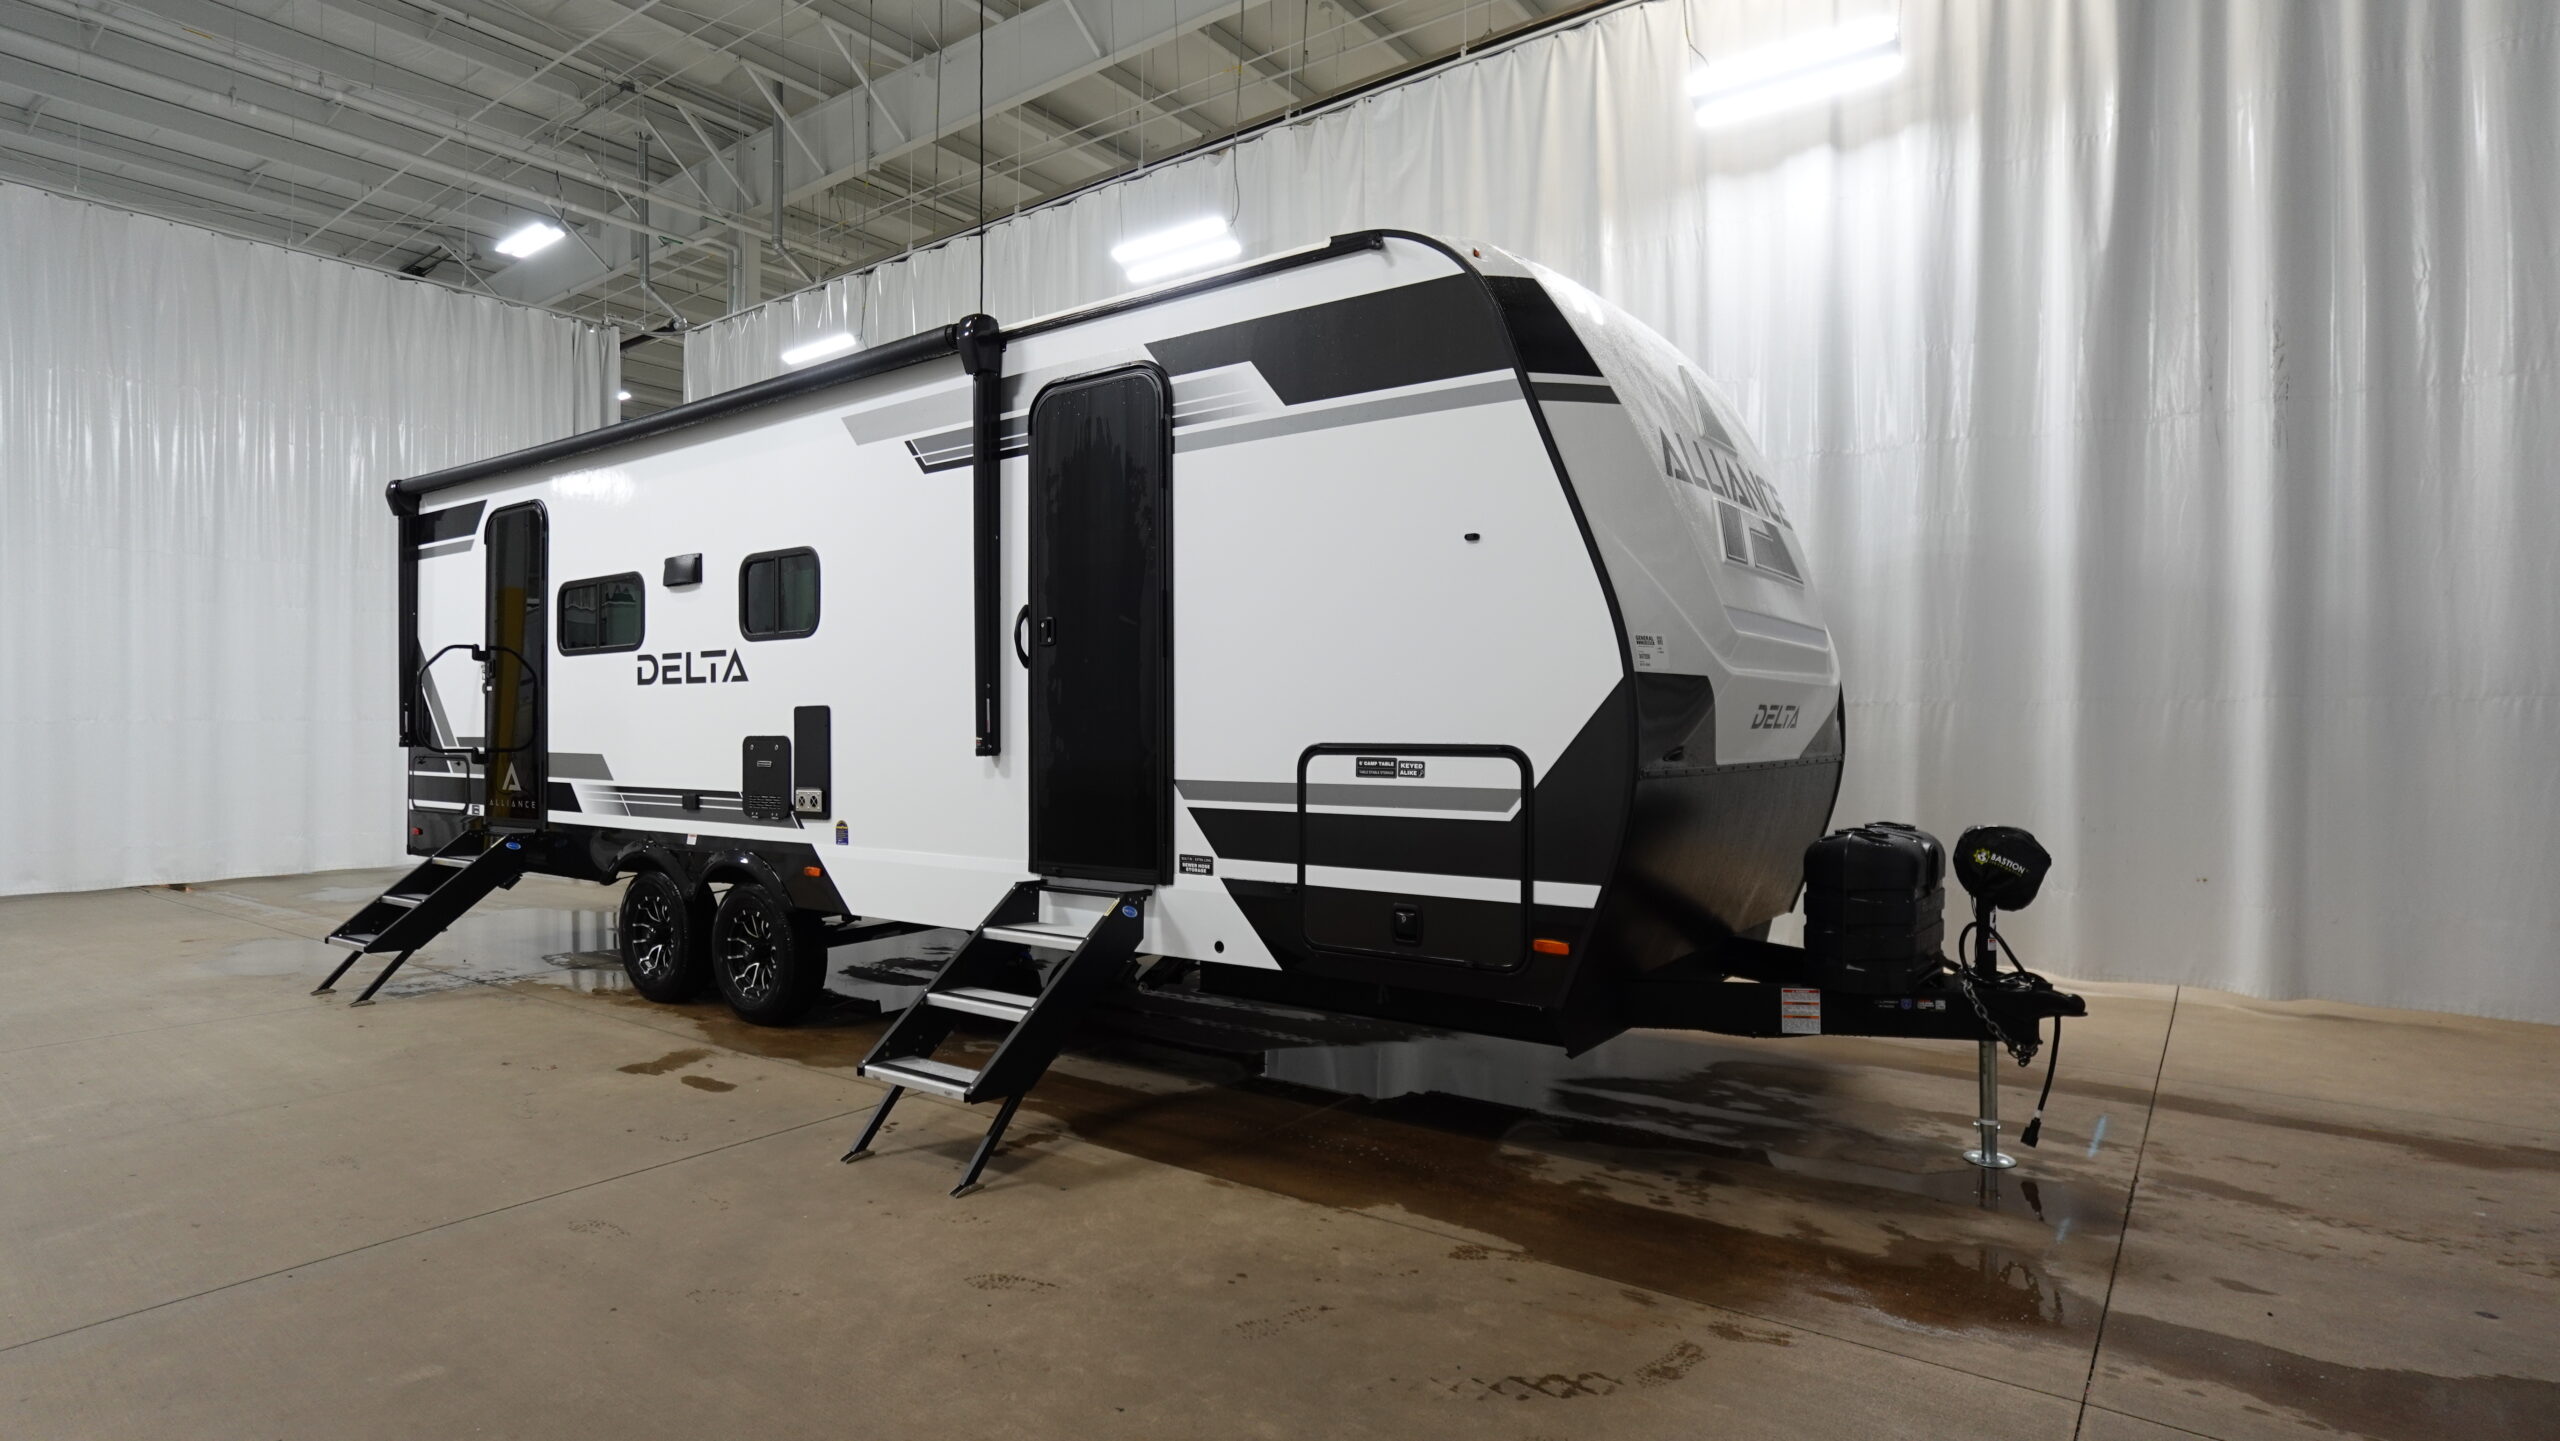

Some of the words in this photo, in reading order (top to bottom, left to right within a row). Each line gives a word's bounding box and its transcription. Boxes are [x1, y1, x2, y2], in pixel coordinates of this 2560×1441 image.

[1659, 425, 1793, 531] ALLIANCE
[637, 648, 749, 685] DELTA
[1751, 704, 1800, 729] DELTA
[489, 799, 537, 809] ALLIANCE
[1990, 853, 2026, 874] BASTION
